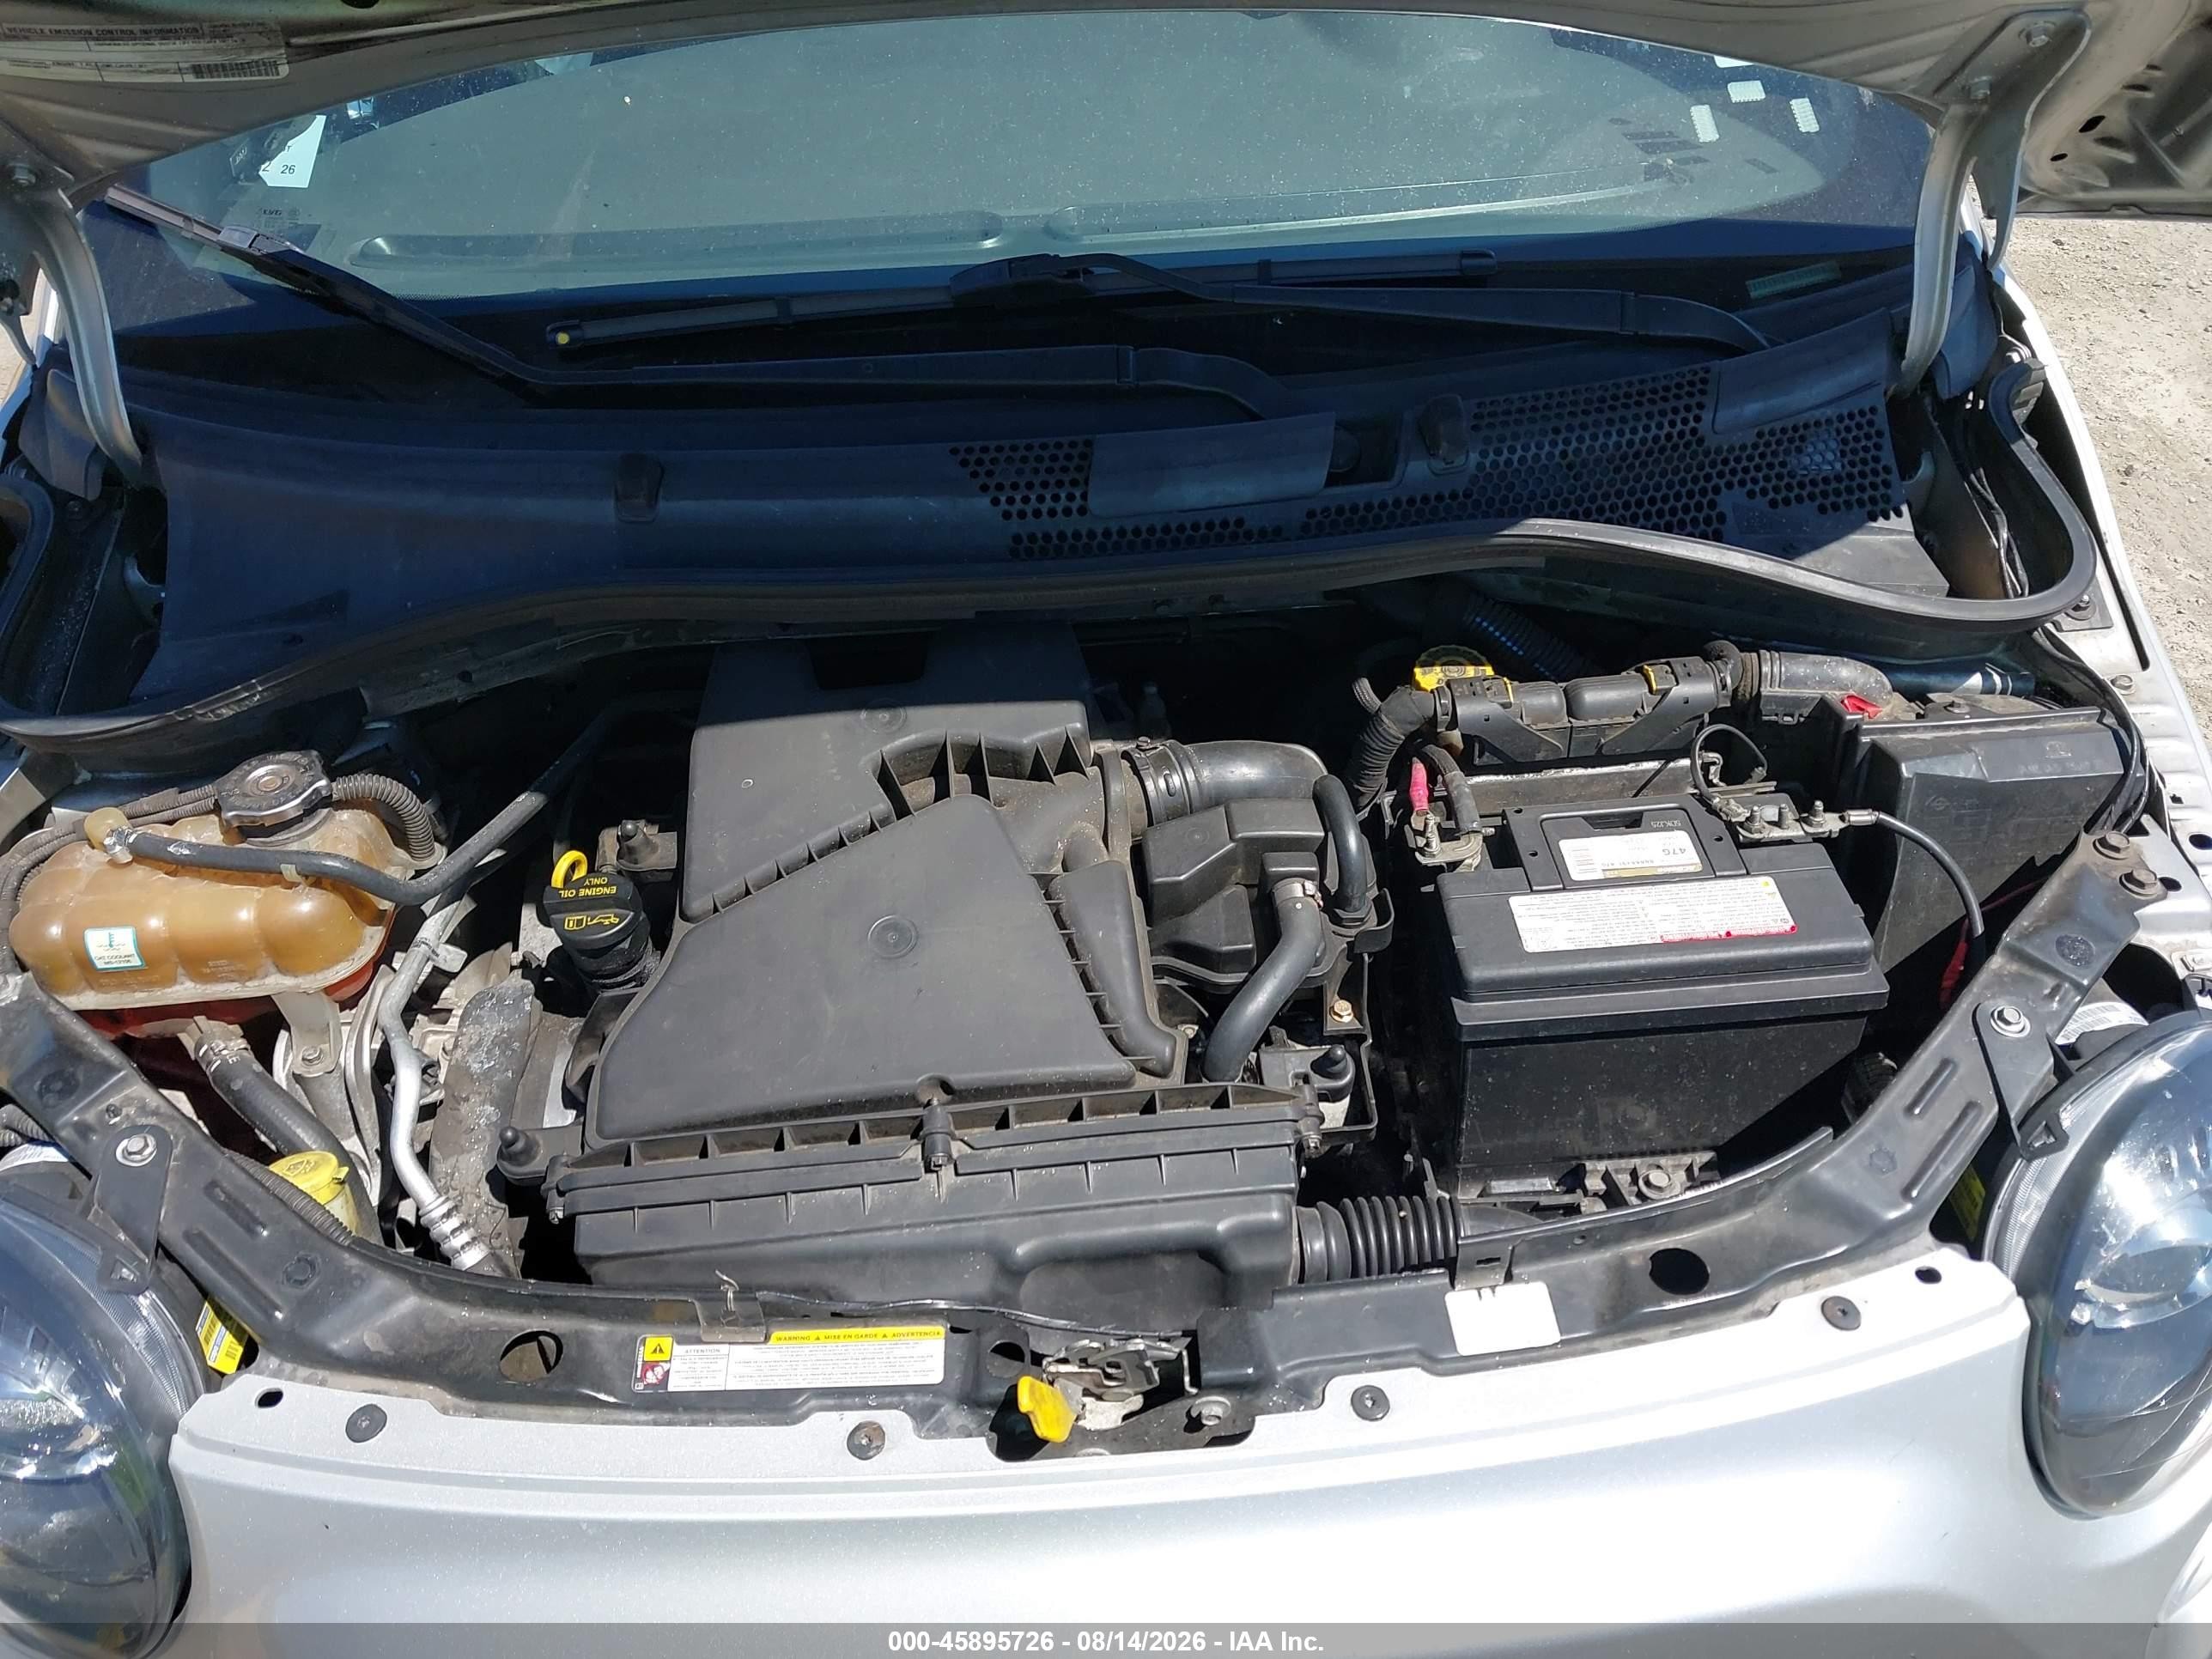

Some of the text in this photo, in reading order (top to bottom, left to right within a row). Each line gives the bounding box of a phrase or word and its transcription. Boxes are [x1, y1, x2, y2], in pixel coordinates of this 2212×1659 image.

[281, 164, 295, 174] 26
[584, 877, 608, 886] ONLY
[558, 885, 617, 898] ENGINE OIL
